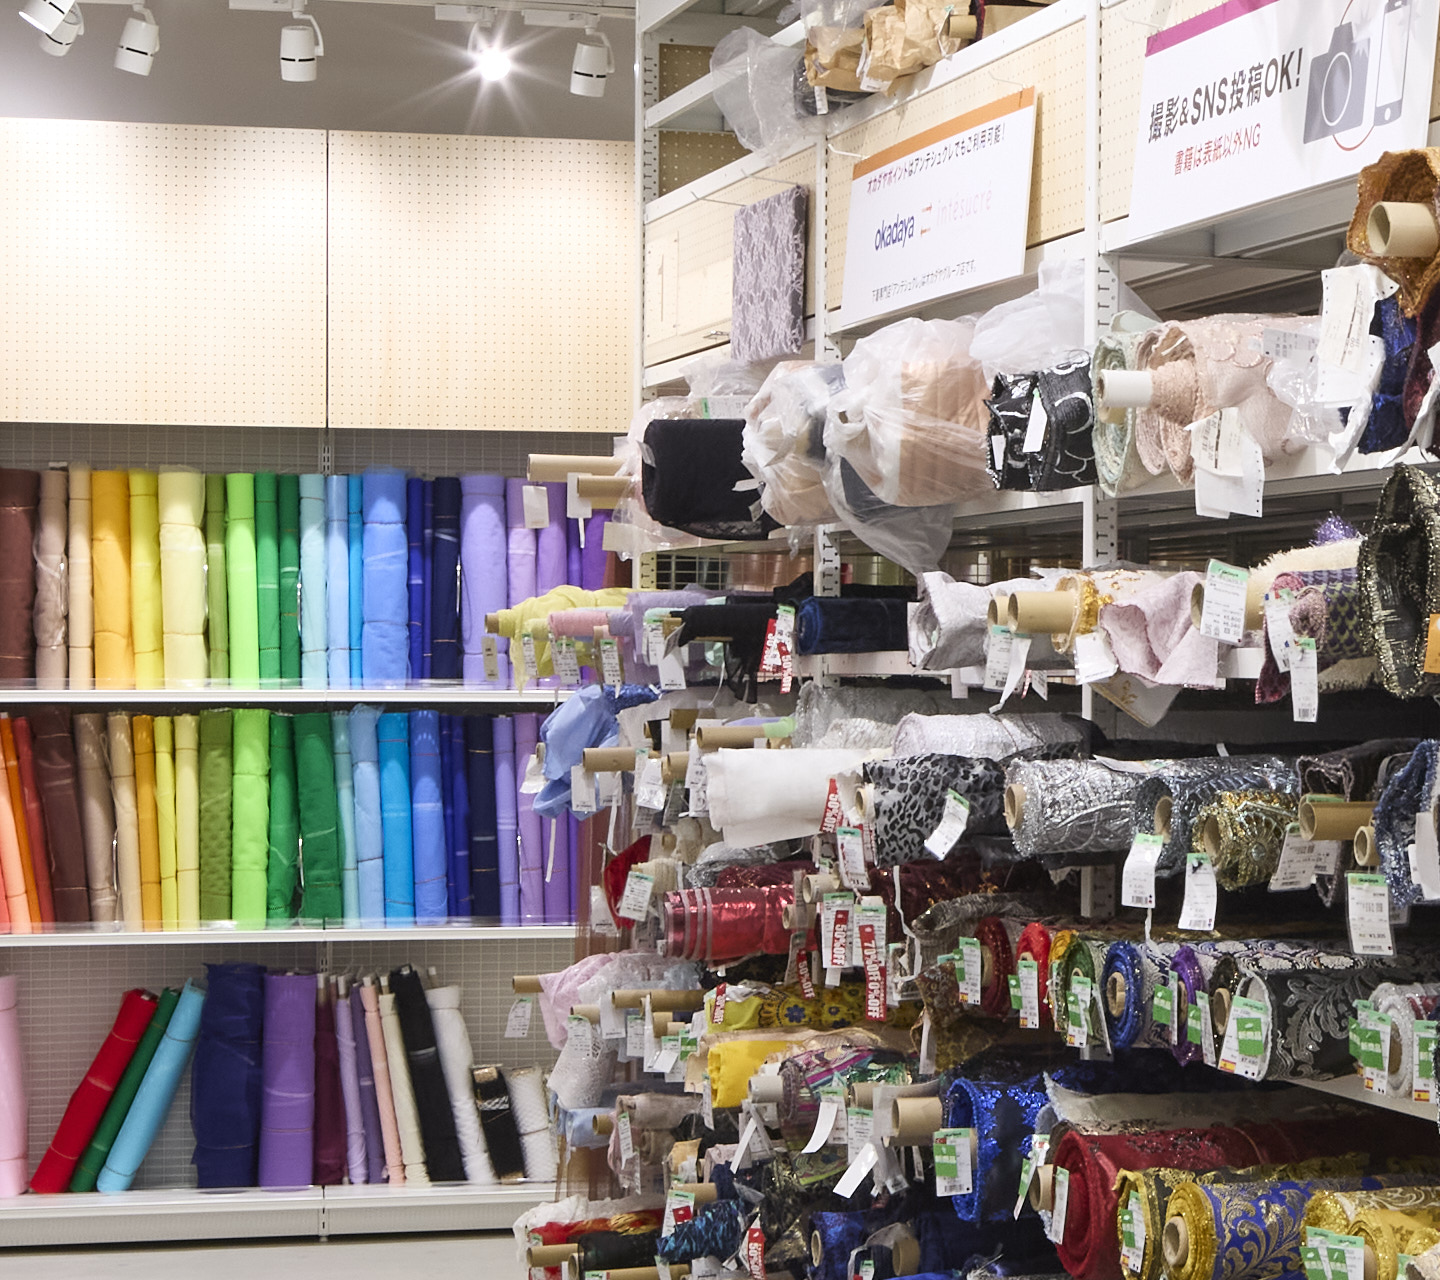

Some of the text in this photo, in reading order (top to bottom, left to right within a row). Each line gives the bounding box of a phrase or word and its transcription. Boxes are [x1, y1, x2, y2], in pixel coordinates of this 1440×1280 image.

[1174, 123, 1261, 176] 書籍は表紙以外NG
[875, 214, 914, 251] okadaya
